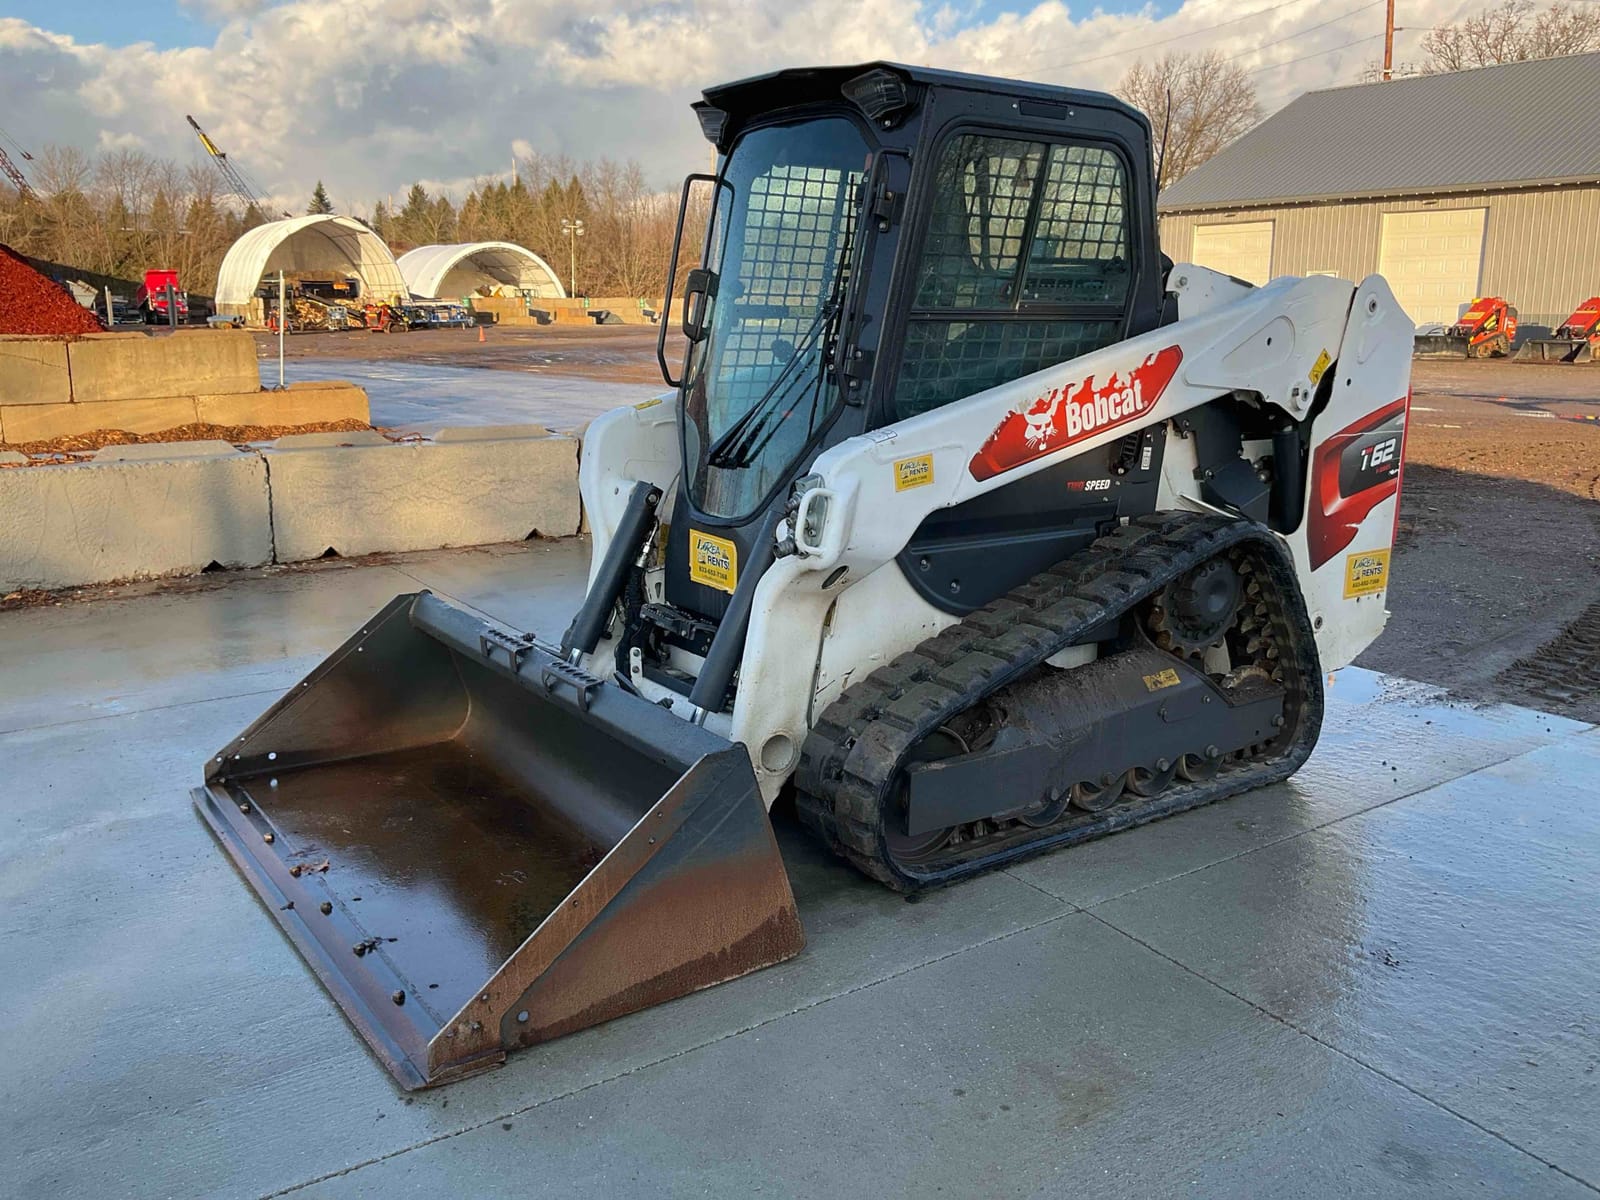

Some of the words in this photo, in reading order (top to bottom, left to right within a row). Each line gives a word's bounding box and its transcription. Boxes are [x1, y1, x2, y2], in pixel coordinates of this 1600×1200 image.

[1065, 379, 1143, 438] Bobcat
[1361, 438, 1396, 471] T62
[1084, 479, 1111, 491] SPEED
[707, 556, 730, 571] RENTS!
